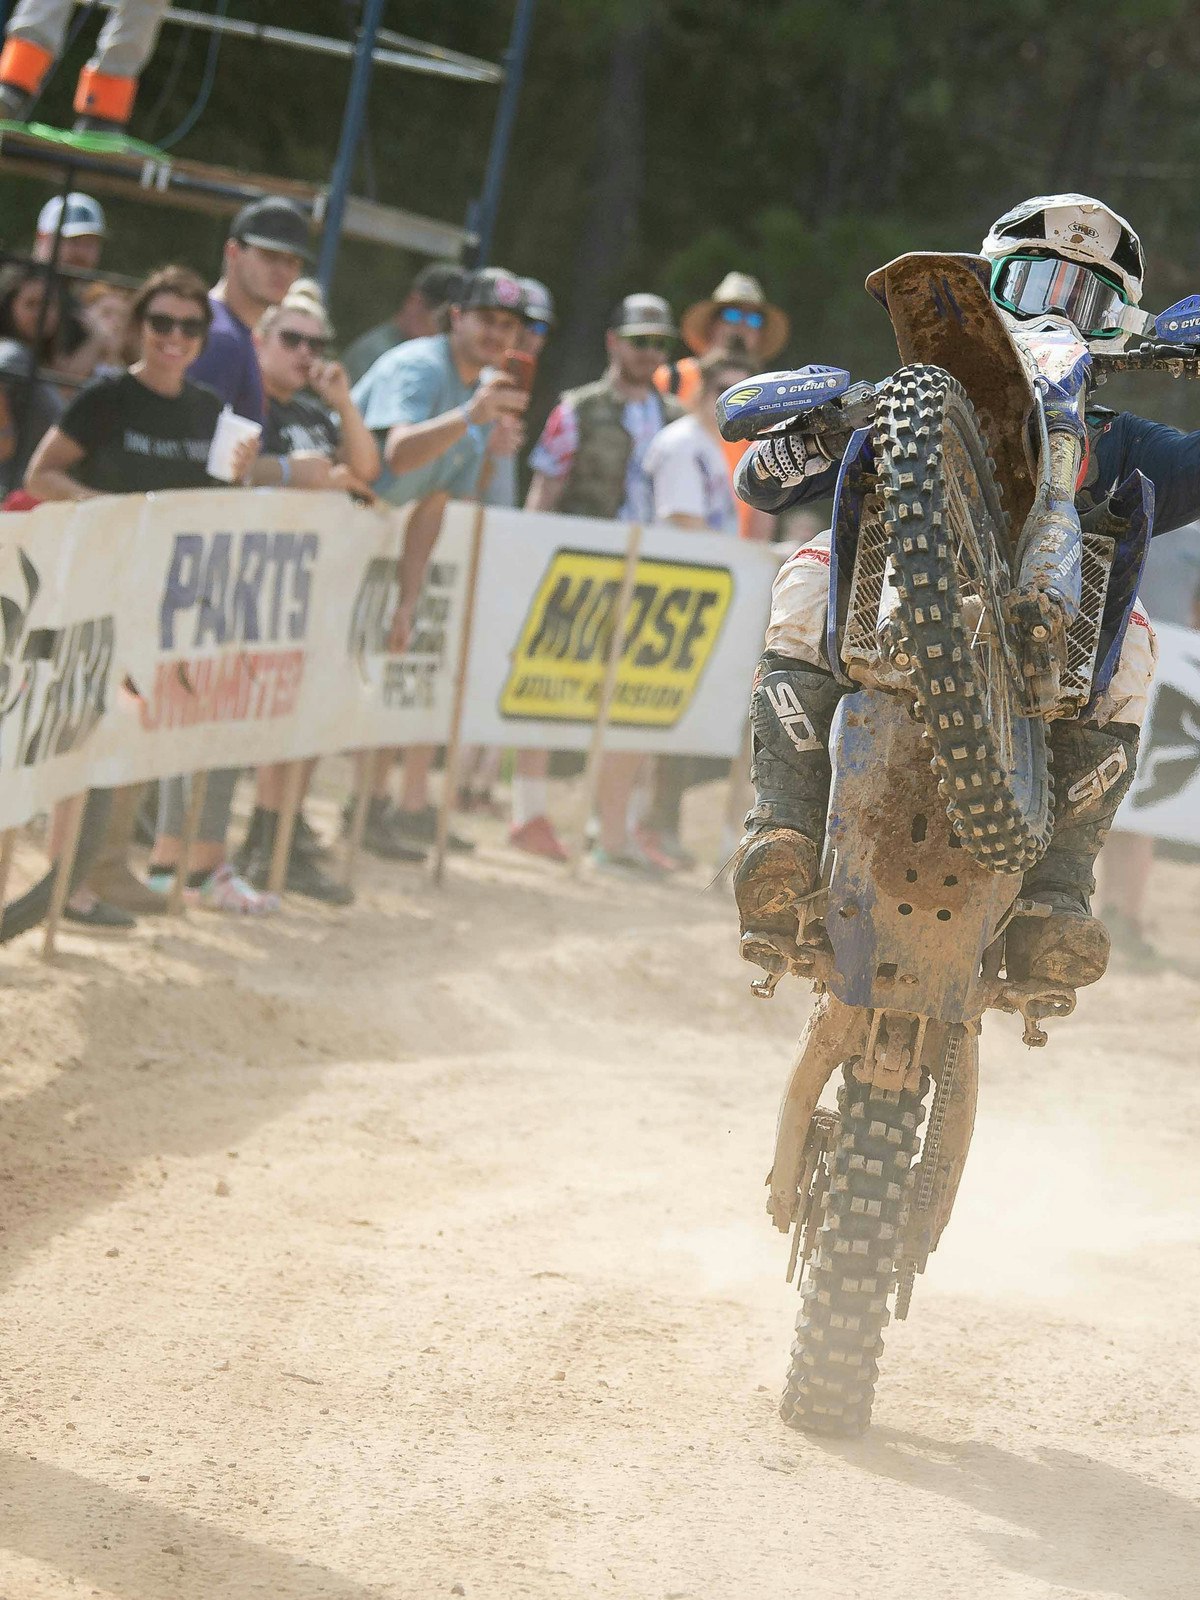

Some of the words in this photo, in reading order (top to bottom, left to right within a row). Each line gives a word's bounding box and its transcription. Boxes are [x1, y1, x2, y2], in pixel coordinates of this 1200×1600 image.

[1072, 224, 1096, 237] SHEI
[789, 381, 825, 393] CYCRA
[160, 532, 320, 651] PARTS
